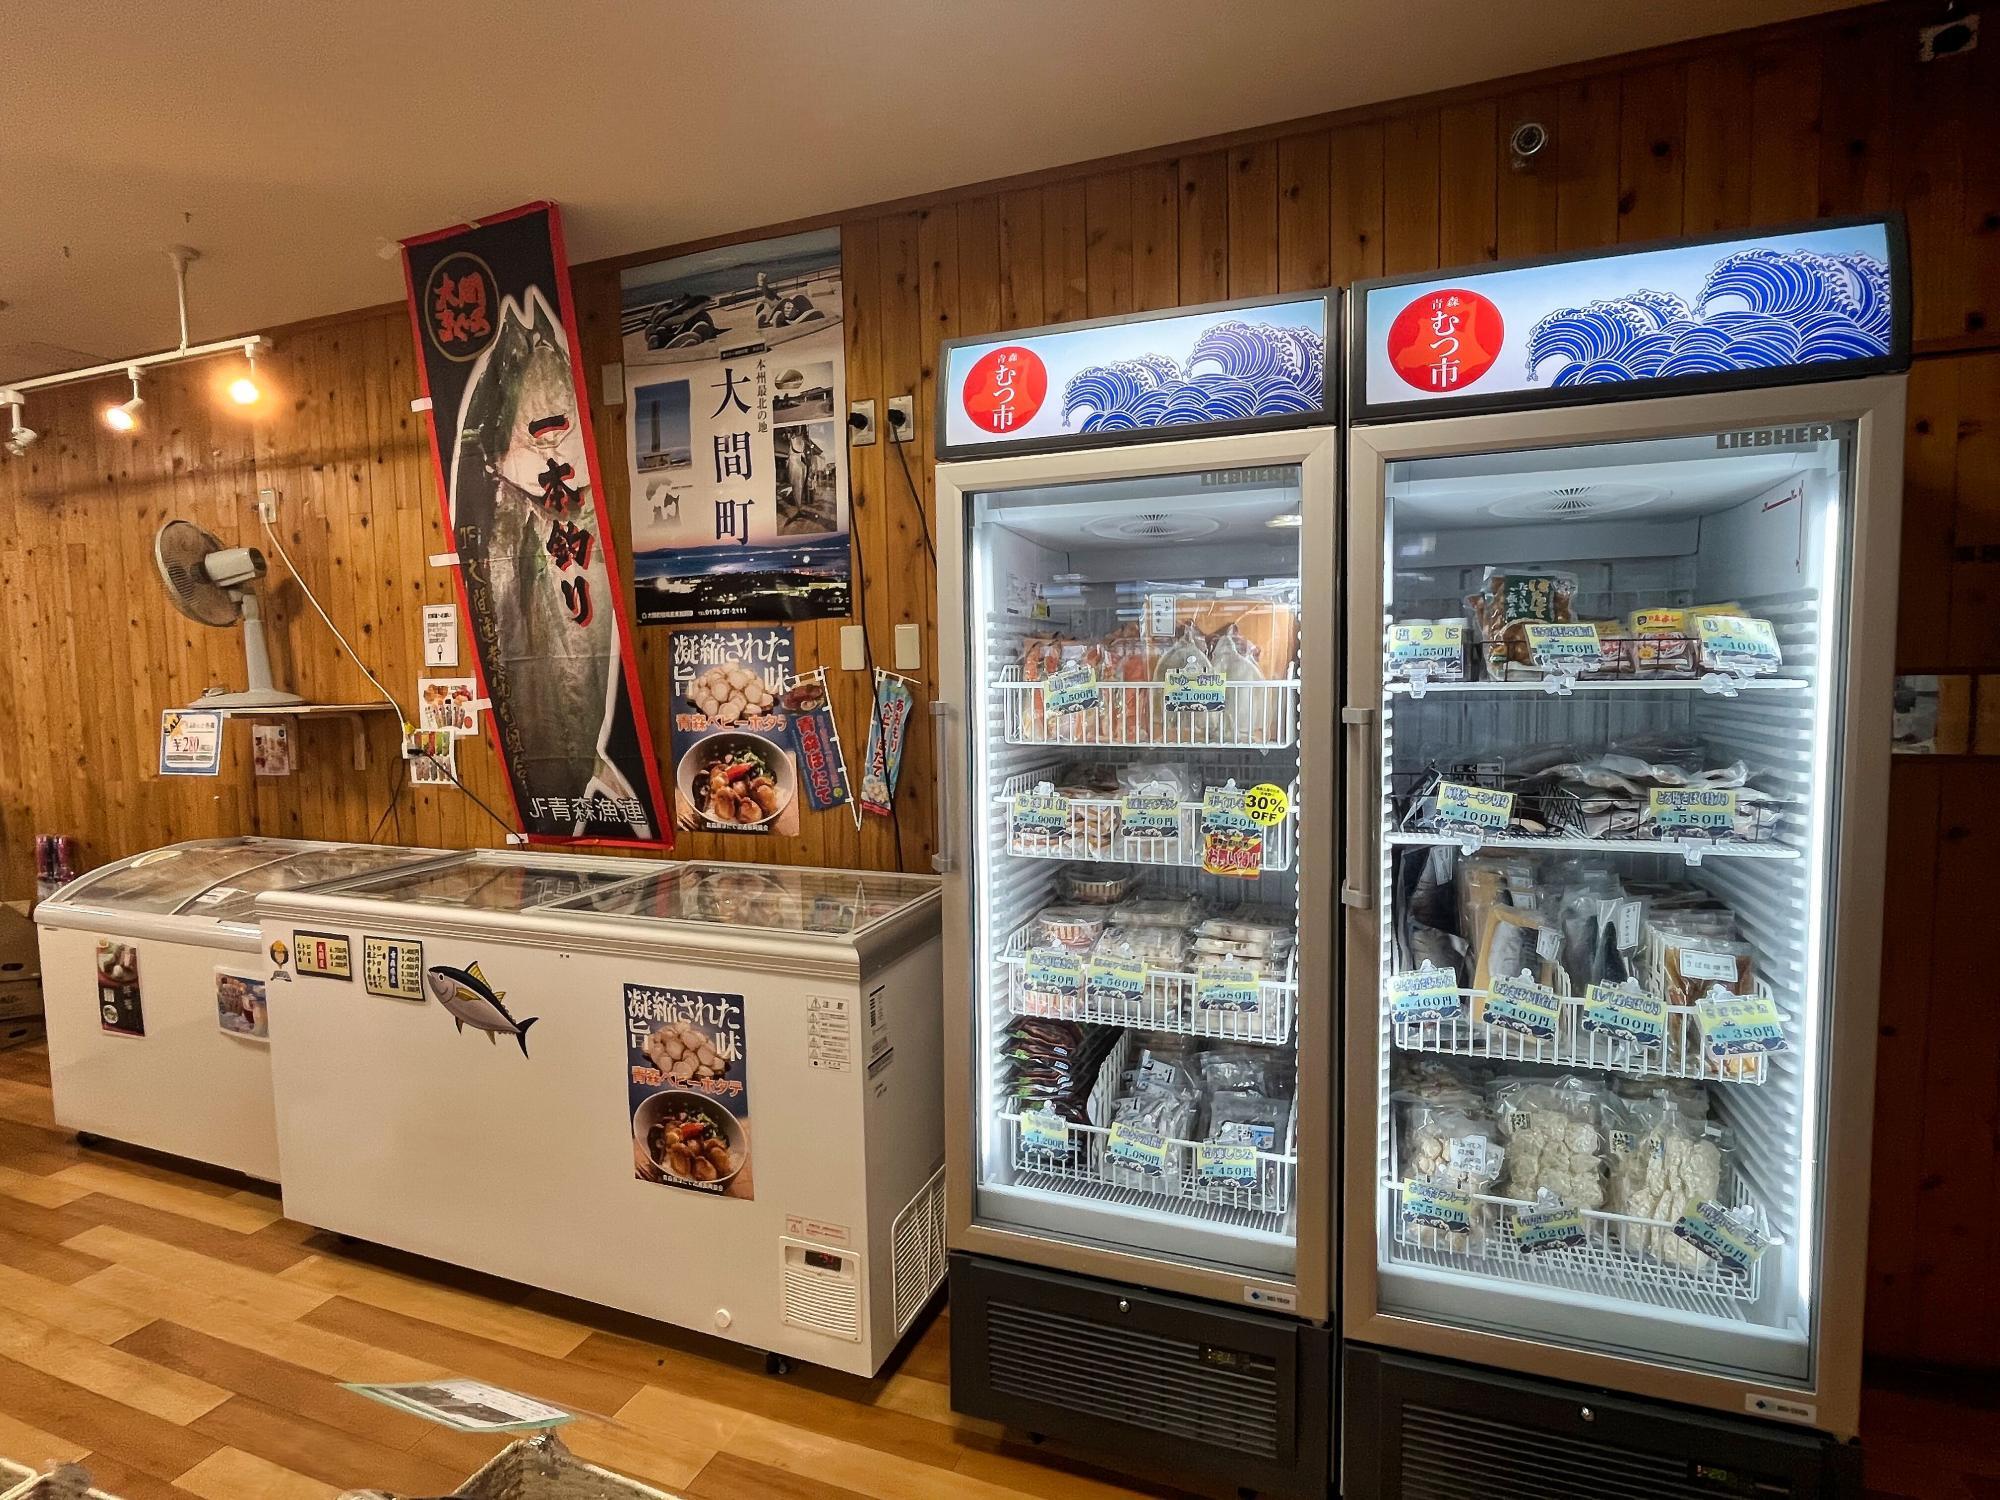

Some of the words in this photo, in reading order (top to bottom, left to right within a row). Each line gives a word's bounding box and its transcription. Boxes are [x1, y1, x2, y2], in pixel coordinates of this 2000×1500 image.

[1431, 295, 1460, 310] 青森
[997, 352, 1018, 365] 青森
[1429, 310, 1461, 388] むつ市
[756, 358, 769, 433] 本州最北の地
[991, 364, 1017, 431] むつ市
[701, 367, 755, 546] 大間町
[527, 413, 595, 628] 一本釣り
[674, 631, 790, 664] 凝縮された
[529, 796, 647, 826] JF青森漁連
[1246, 794, 1285, 814] 30%
[1251, 810, 1277, 822] OFF
[1679, 814, 1726, 825] 580円
[627, 988, 740, 1029] 凝縮された
[1508, 1008, 1550, 1027] 400円
[1609, 1015, 1655, 1033] 400円
[1733, 1025, 1776, 1038] 380円
[1425, 1205, 1465, 1221] 550円
